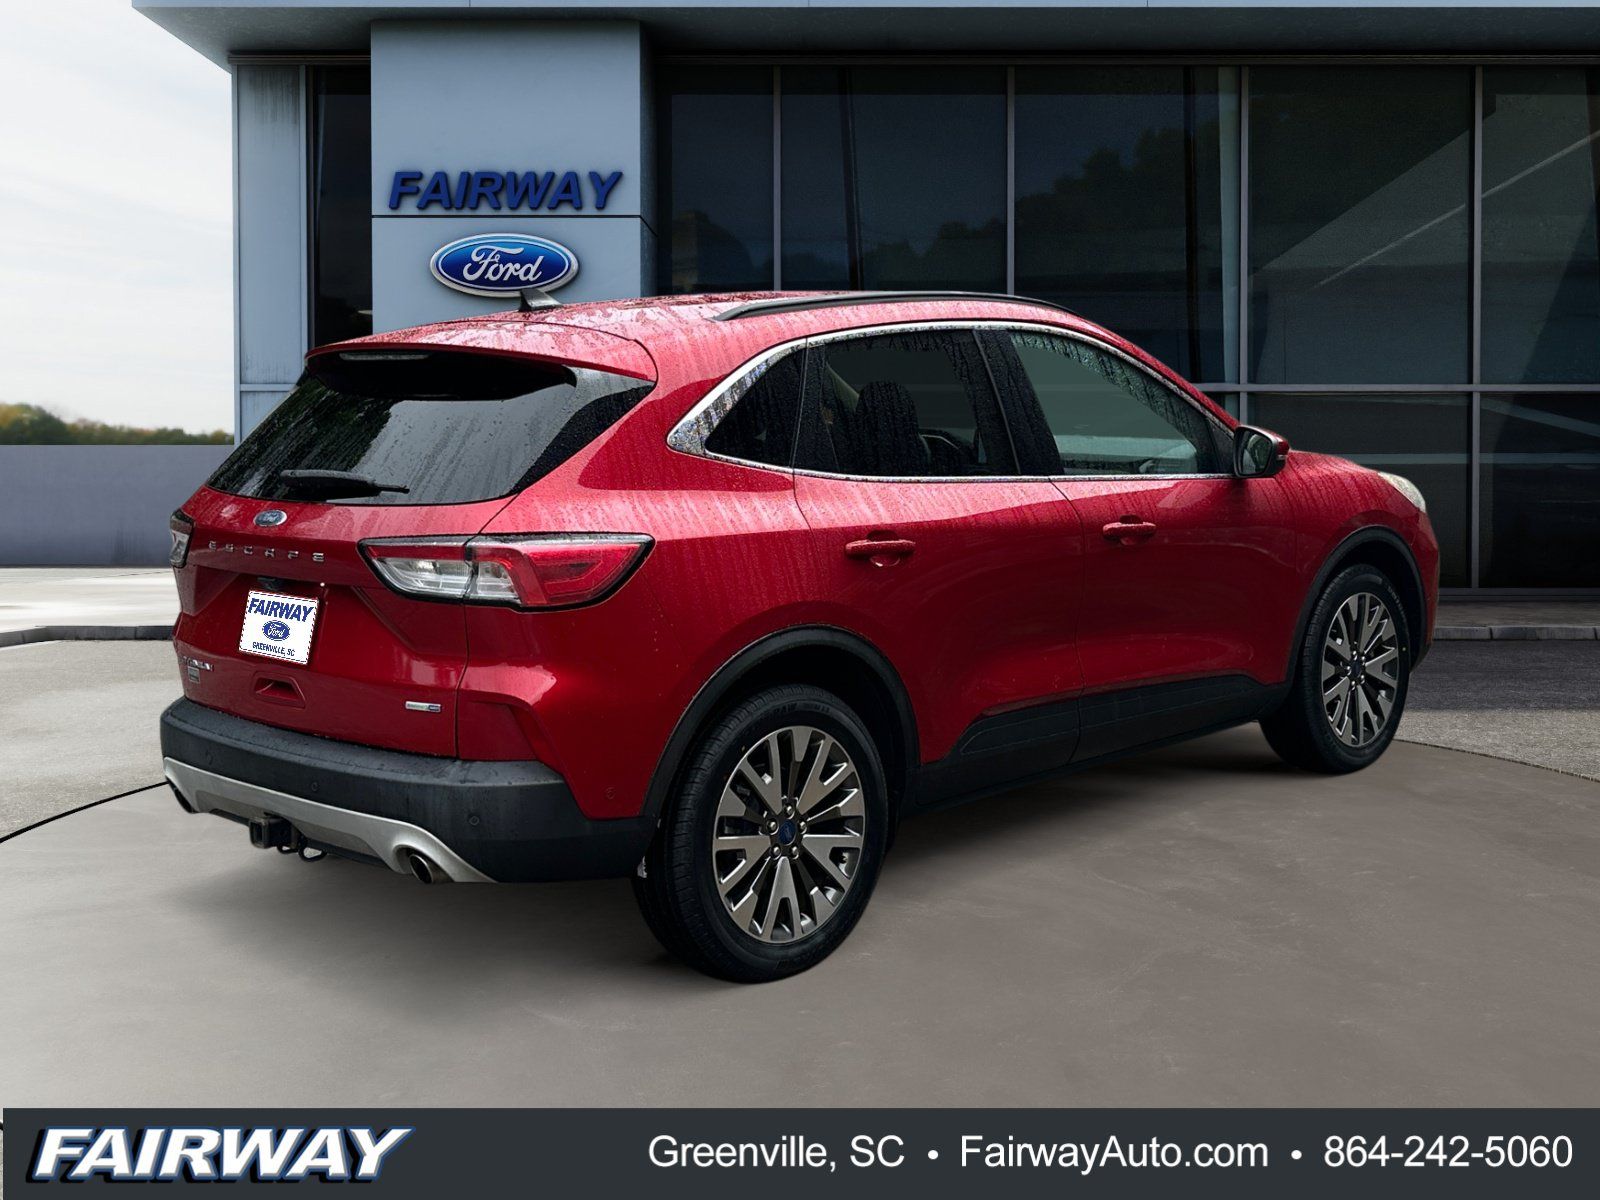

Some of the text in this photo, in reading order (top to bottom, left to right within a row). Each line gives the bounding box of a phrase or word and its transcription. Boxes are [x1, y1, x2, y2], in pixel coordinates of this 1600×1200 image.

[388, 171, 623, 210] FAIRWAY
[462, 245, 544, 281] Ford
[208, 540, 325, 562] ESCAPE
[248, 598, 314, 622] FAIRWAY
[267, 623, 286, 637] Ford
[286, 648, 296, 656] SC
